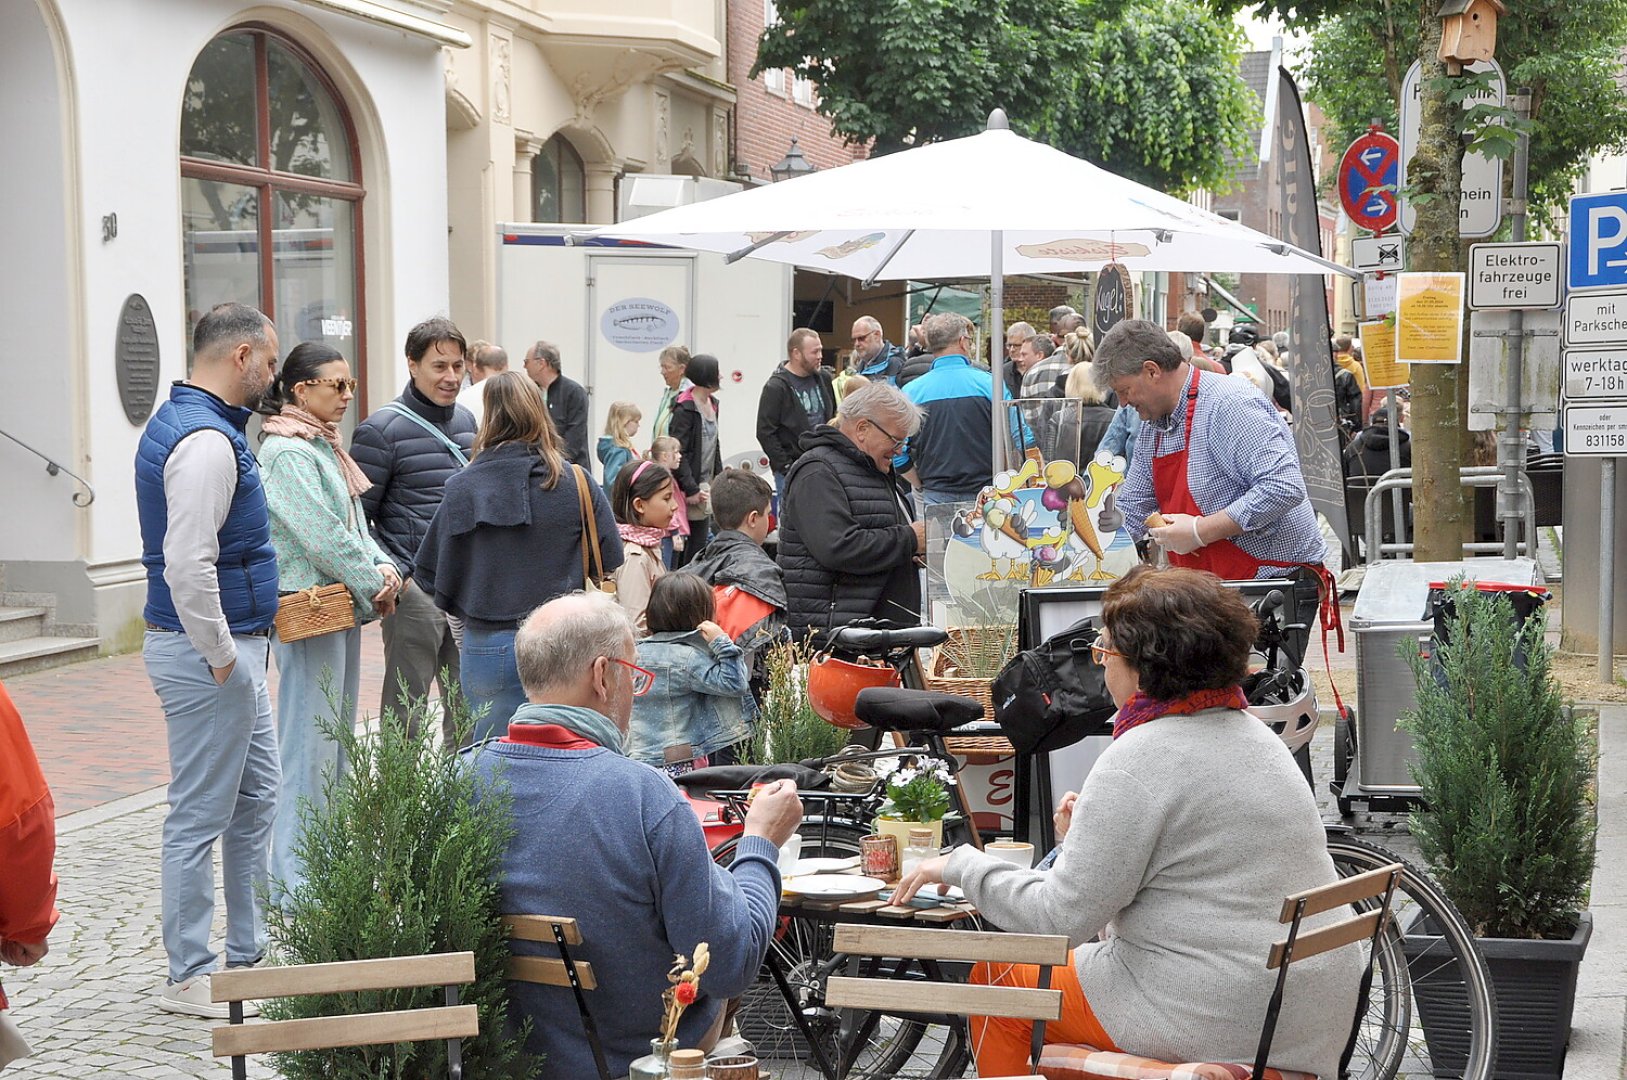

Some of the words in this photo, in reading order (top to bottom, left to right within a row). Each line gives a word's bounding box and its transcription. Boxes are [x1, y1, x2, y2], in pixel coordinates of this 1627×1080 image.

[1486, 254, 1545, 267] Elektro-
[1479, 271, 1551, 285] fahrzeuge
[1502, 286, 1527, 299] frei
[608, 305, 627, 314] DER
[628, 303, 671, 315] SEEWOLF
[1597, 302, 1615, 315] mit
[1599, 413, 1612, 421] oder
[1573, 423, 1605, 431] Kennzeichen
[1607, 424, 1616, 432] per
[1586, 434, 1625, 447] 831158
